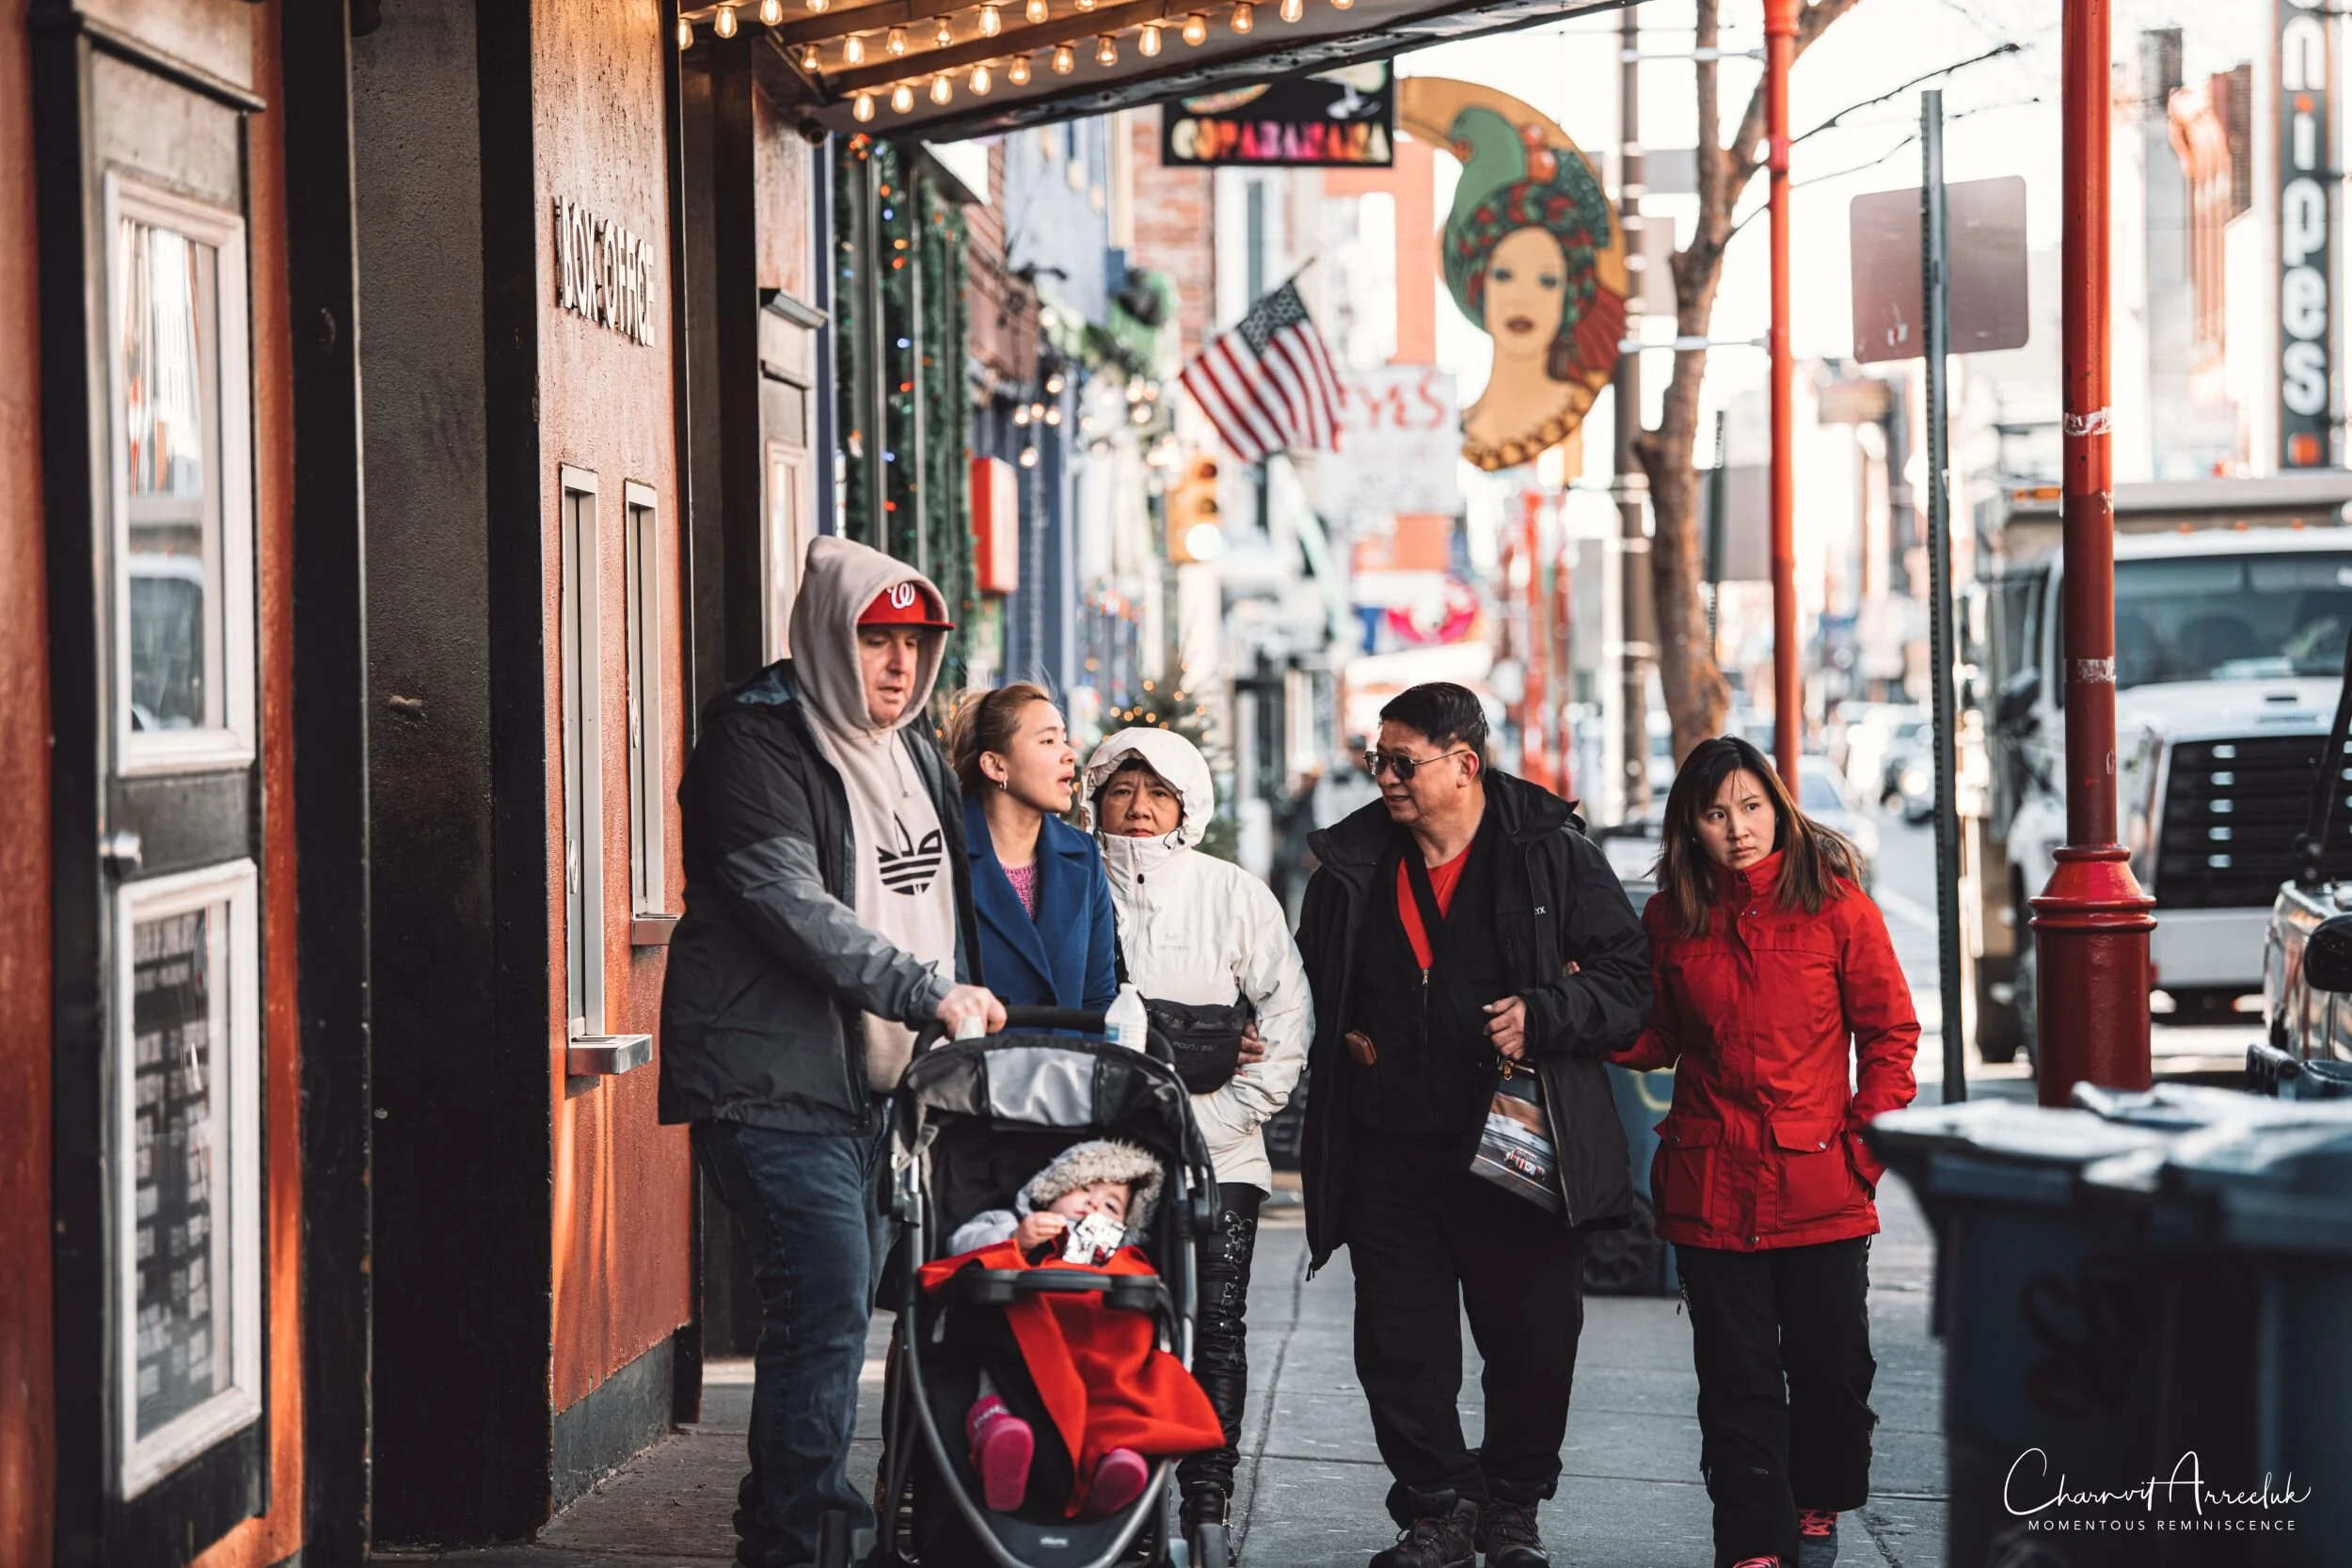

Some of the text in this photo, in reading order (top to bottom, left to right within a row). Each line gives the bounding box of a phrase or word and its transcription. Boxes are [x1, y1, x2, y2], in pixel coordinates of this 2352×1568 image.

[560, 195, 655, 347] BOX OFFICE
[2282, 0, 2328, 416] nipes
